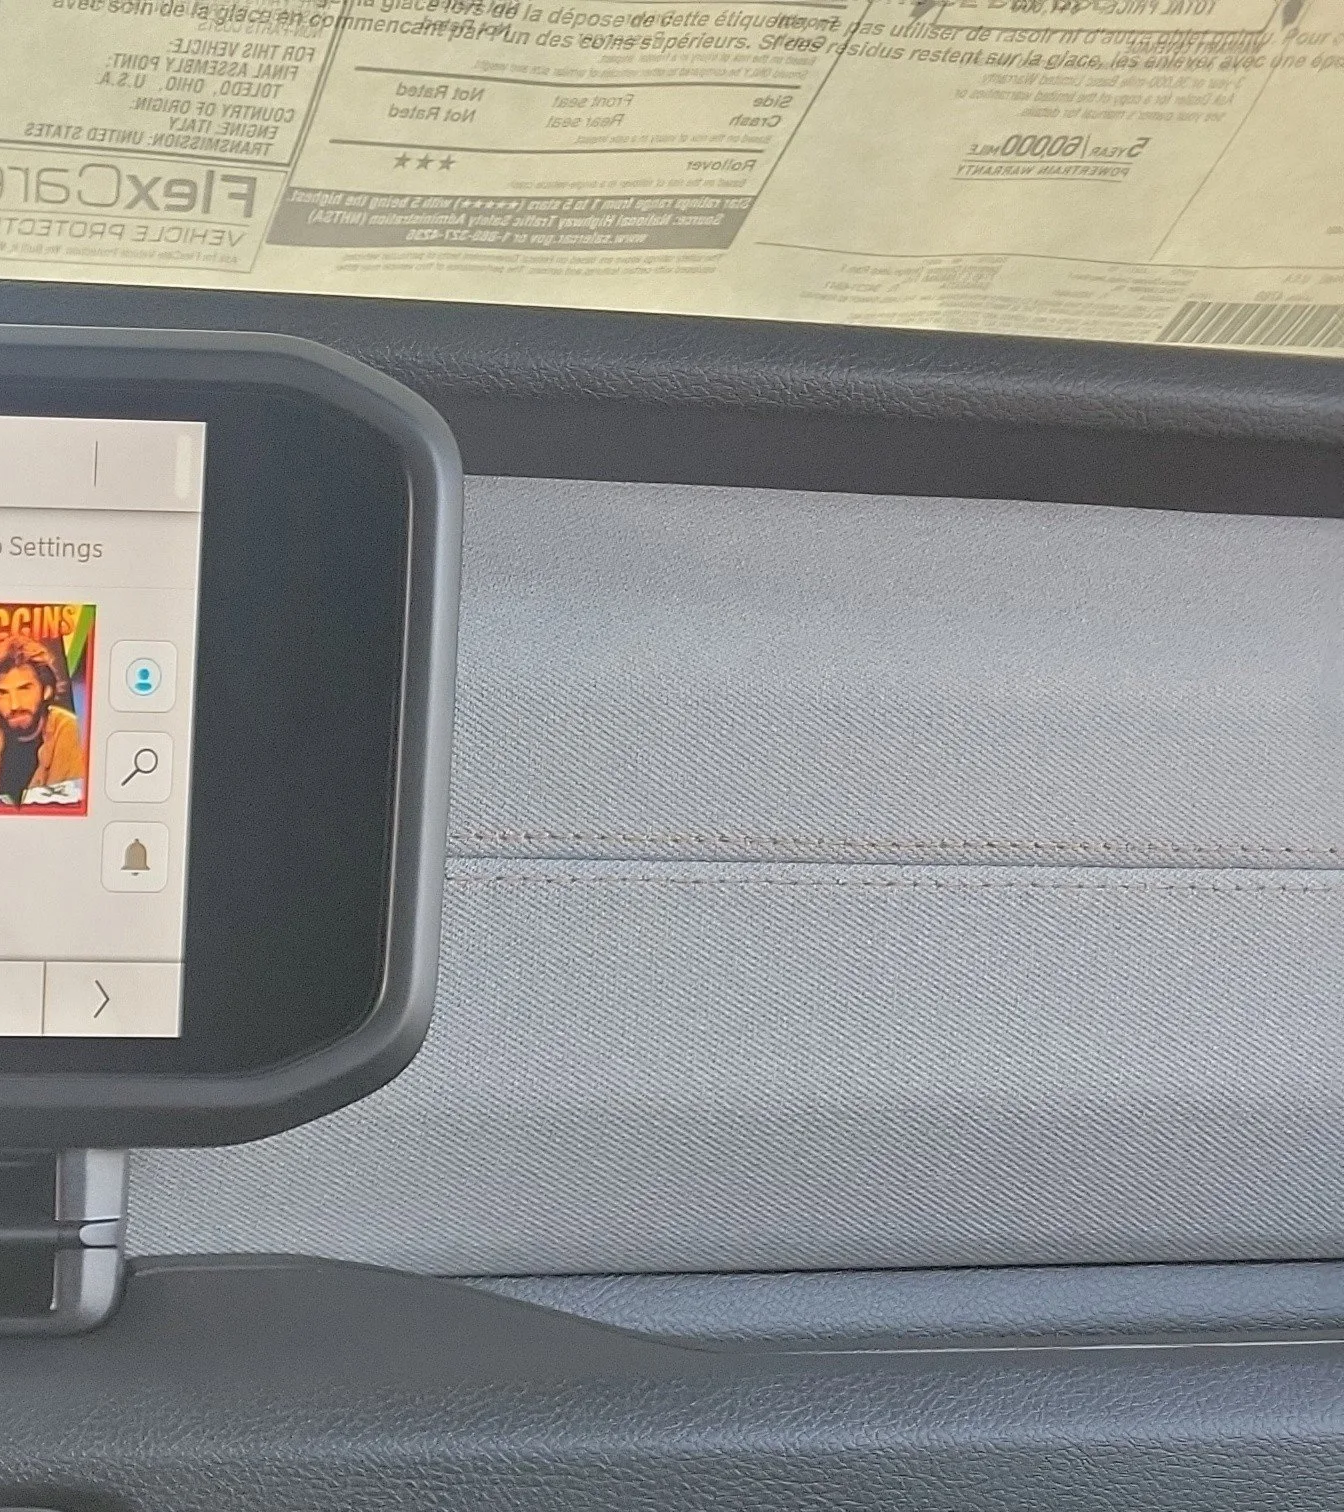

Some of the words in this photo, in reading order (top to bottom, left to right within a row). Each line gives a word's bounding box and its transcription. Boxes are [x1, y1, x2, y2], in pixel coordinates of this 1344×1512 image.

[523, 5, 543, 22] la
[548, 7, 625, 29] dépose
[8, 535, 104, 565] Settings
